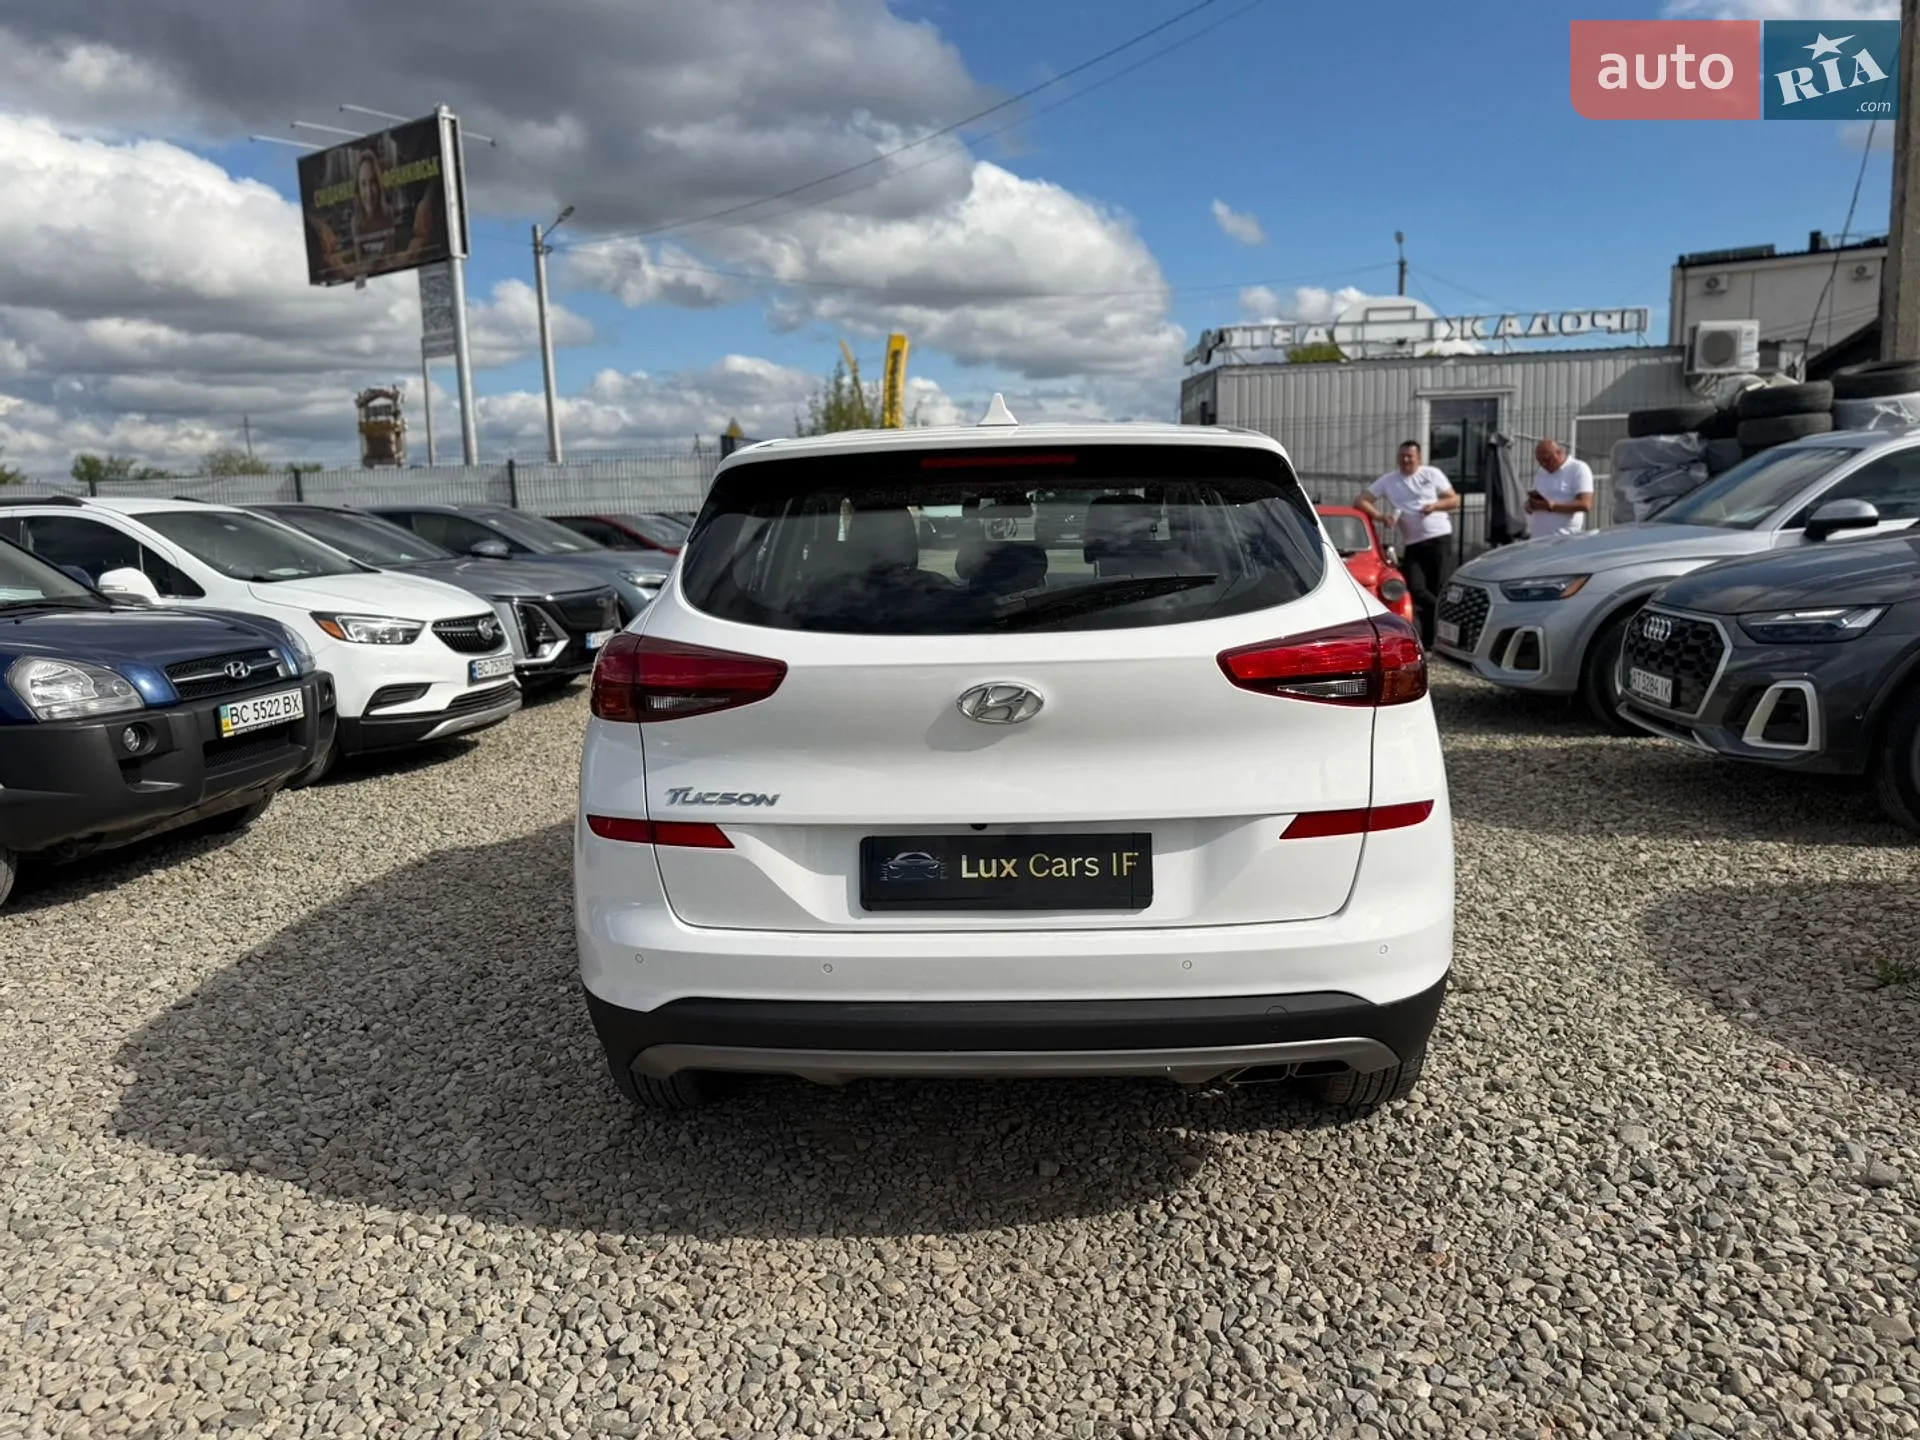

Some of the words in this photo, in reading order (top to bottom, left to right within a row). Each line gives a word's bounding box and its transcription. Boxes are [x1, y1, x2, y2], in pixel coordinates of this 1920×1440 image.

[230, 705, 250, 726] BC
[253, 698, 281, 720] 5522
[283, 693, 300, 715] BX
[664, 787, 781, 807] TUCSON
[961, 854, 1019, 879] Lux
[1029, 852, 1100, 878] Cars
[1112, 851, 1140, 877] IF
